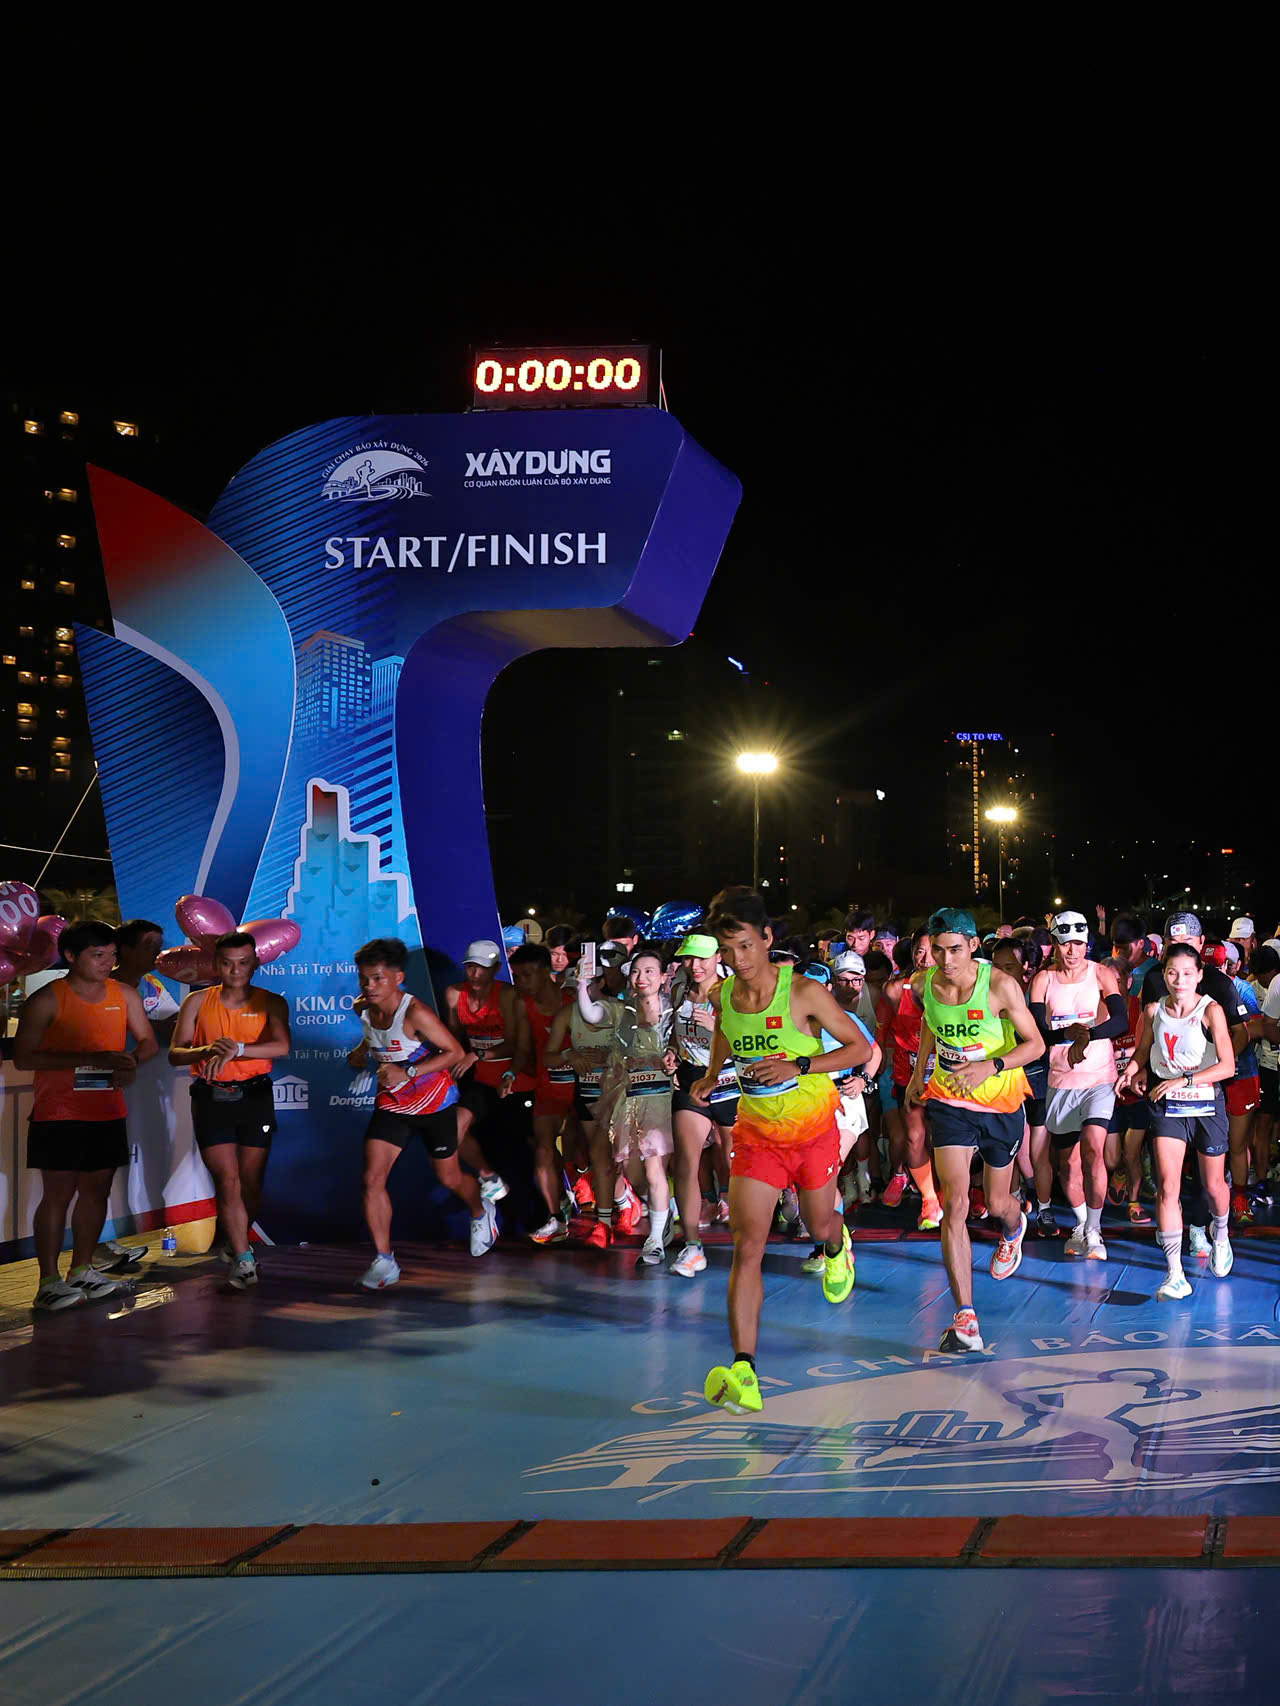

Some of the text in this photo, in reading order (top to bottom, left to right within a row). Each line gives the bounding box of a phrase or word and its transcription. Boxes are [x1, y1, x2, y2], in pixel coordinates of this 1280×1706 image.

[475, 358, 641, 393] 0:00:00
[413, 452, 430, 467] 2026
[476, 480, 498, 489] QUAN
[499, 478, 521, 487] NGÔN
[324, 532, 607, 573] START/FINISH
[260, 964, 286, 976] Nhà
[289, 963, 308, 975] Tài
[313, 963, 333, 977] Trợ
[295, 995, 335, 1012] KIM
[296, 1014, 346, 1026] GROUP
[936, 1023, 980, 1038] eBRC
[678, 1034, 708, 1045] TOKYO
[733, 1034, 779, 1052] eBRC
[294, 1046, 350, 1061] Tài Trợ Đồ
[941, 1049, 968, 1063] 21724
[631, 1073, 656, 1083] 21037
[717, 1075, 736, 1085] 2192
[273, 1085, 309, 1102] DIC
[1171, 1091, 1200, 1099] 21564
[329, 1095, 375, 1107] Dongta
[631, 1376, 793, 1413] GII
[1030, 1330, 1169, 1351] BÁO
